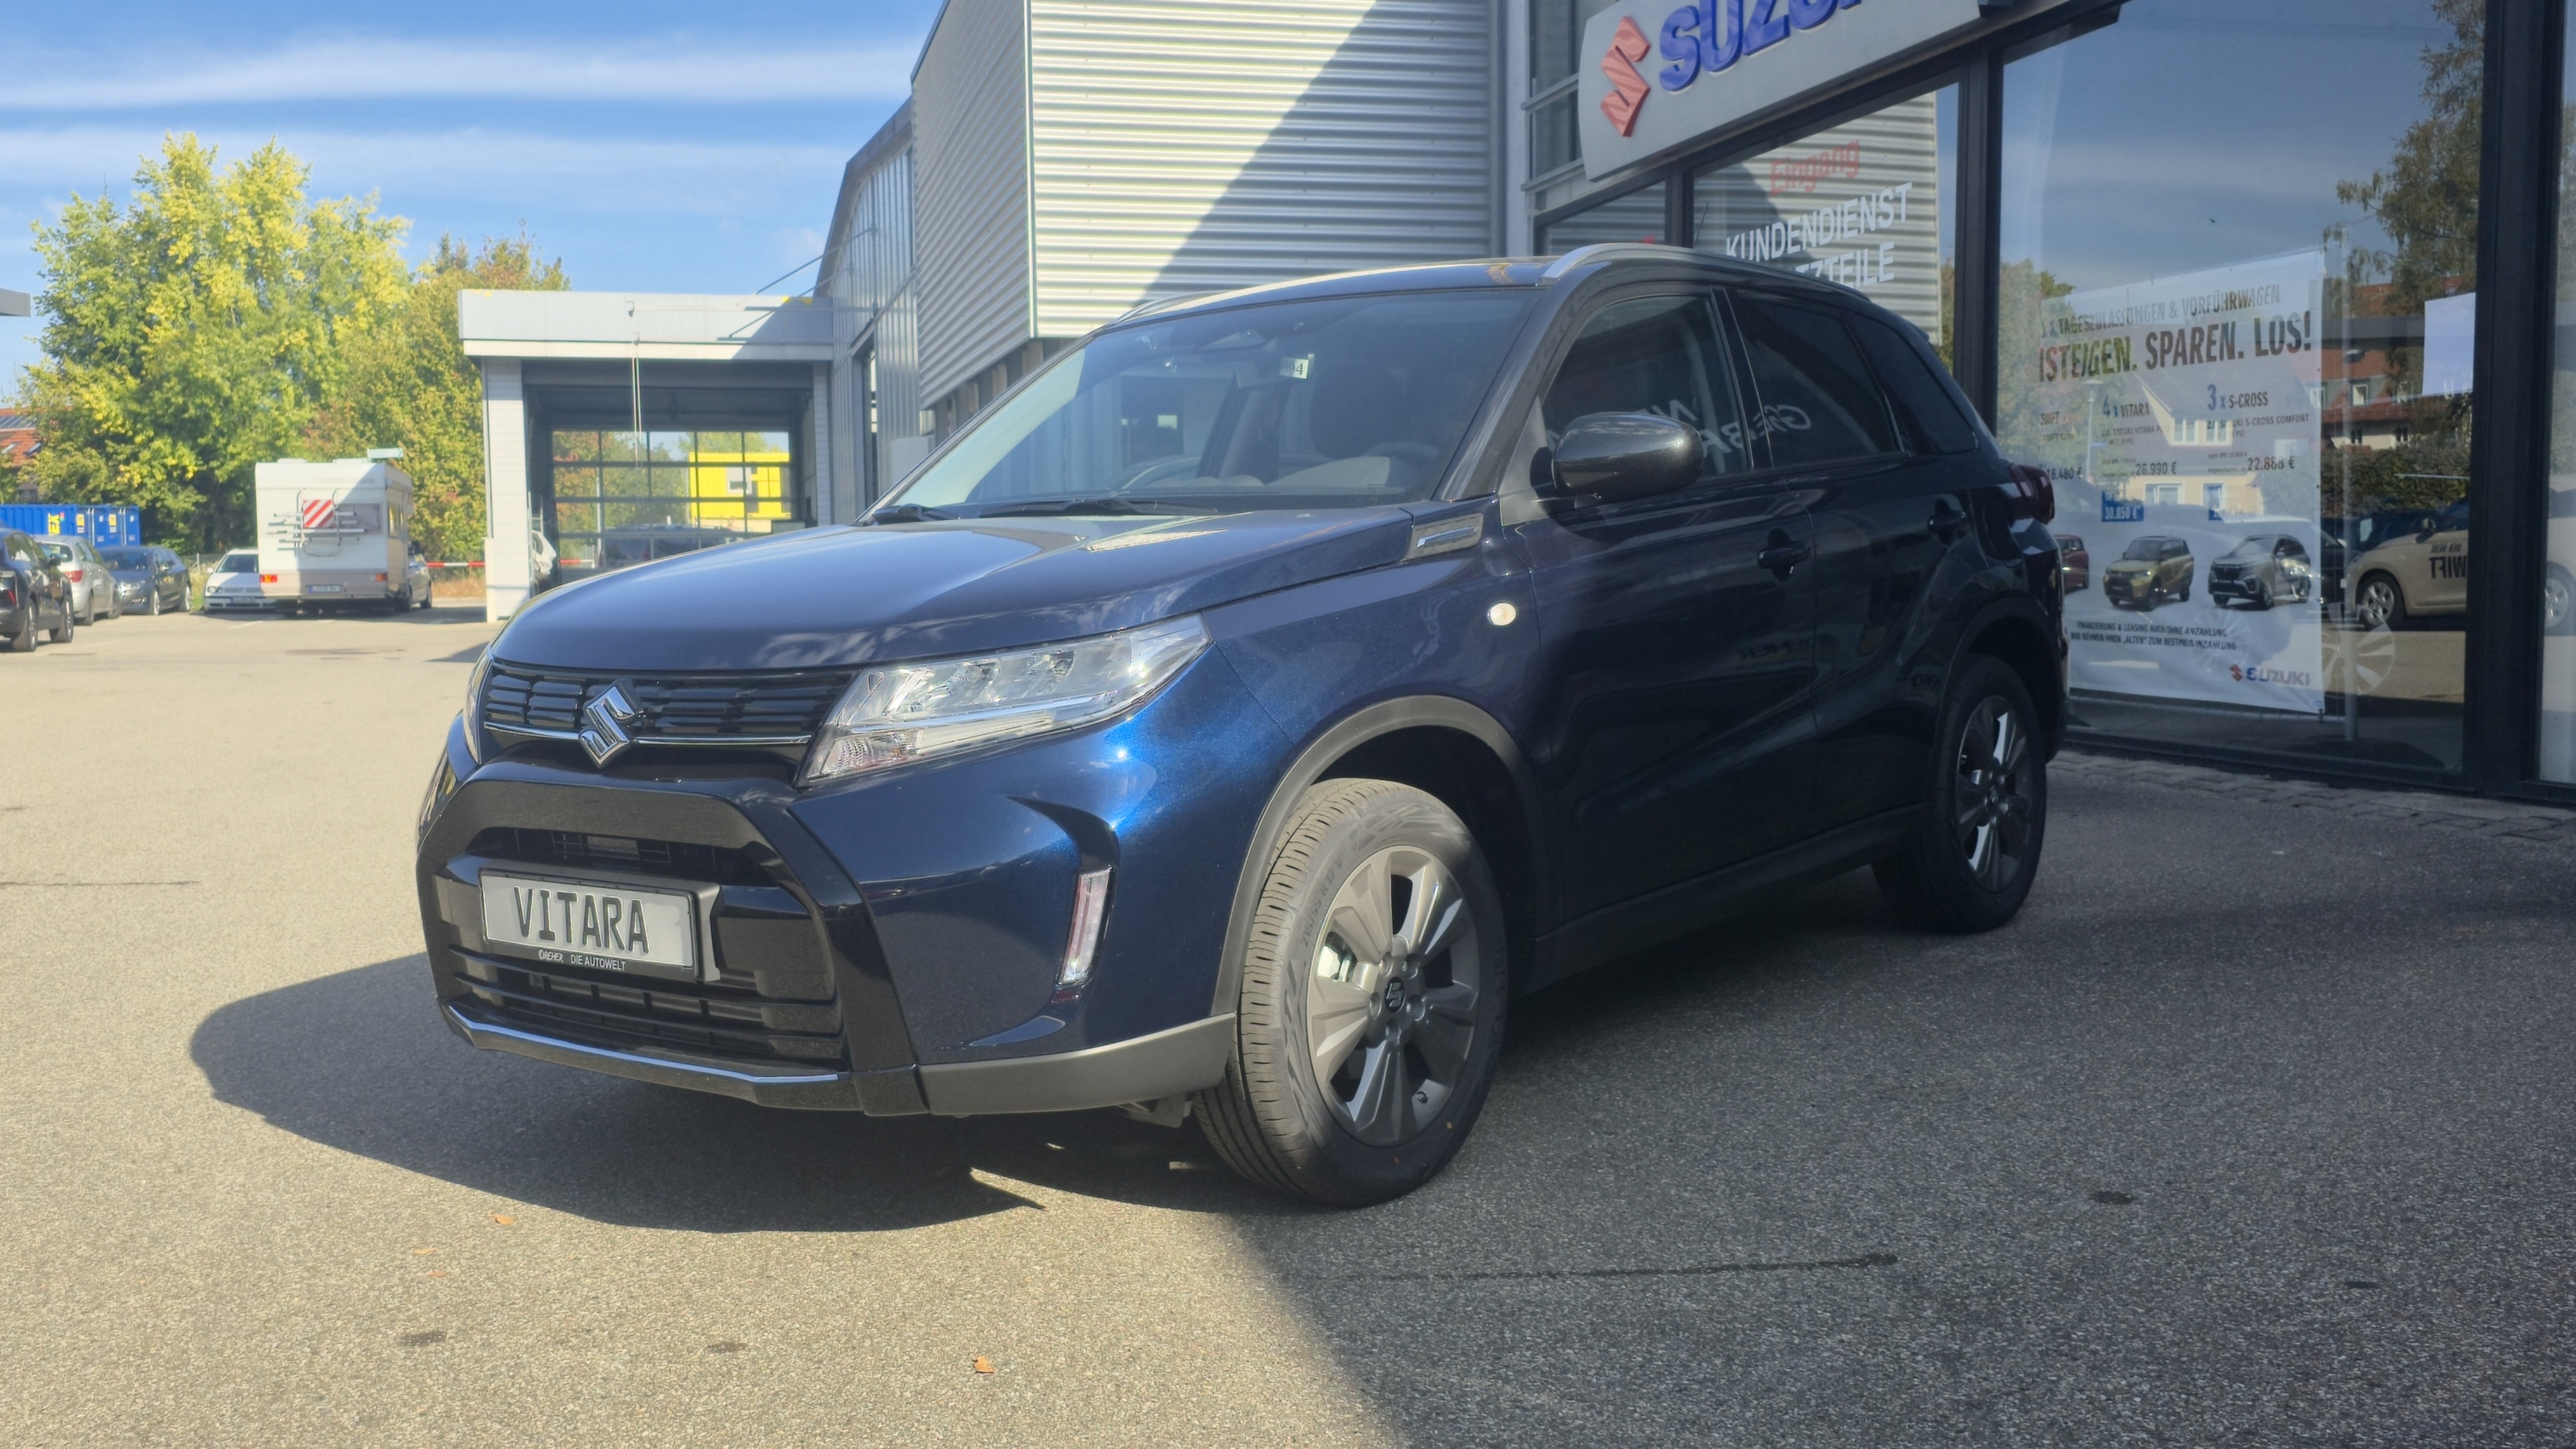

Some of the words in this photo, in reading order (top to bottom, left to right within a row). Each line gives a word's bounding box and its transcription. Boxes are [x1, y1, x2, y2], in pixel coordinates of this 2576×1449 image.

[1659, 0, 1862, 92] SUZ
[1770, 139, 1859, 195] Eingang
[1726, 182, 1912, 262] KUNDENDIENST
[1796, 241, 1894, 288] TEILE
[2058, 302, 2165, 335] TAGESZULASSUNGEN
[2169, 301, 2178, 318] &
[2182, 284, 2280, 316] VORFÜHRWAGEN
[2145, 321, 2244, 370] SPAREN.
[2254, 311, 2311, 357] LOS!
[2207, 383, 2217, 411] 3
[2229, 392, 2269, 409] S-CROSS
[2120, 402, 2150, 418] VITARA
[2245, 416, 2274, 426] S-CROSS
[2276, 414, 2310, 424] COMFORT
[2135, 462, 2168, 476] 26.990
[2171, 461, 2177, 475] €
[2288, 456, 2295, 469] €
[2124, 623, 2148, 632] LEASING
[2149, 625, 2166, 634] AUCH
[2184, 627, 2228, 637] ANZAHLUNG
[2148, 637, 2162, 645] ZUM
[2164, 638, 2195, 648] BESTPREIS
[2246, 667, 2310, 686] SUZUKI
[514, 886, 650, 953] VITARA
[571, 954, 584, 965] DIE
[585, 956, 626, 971] AUTOWELT
